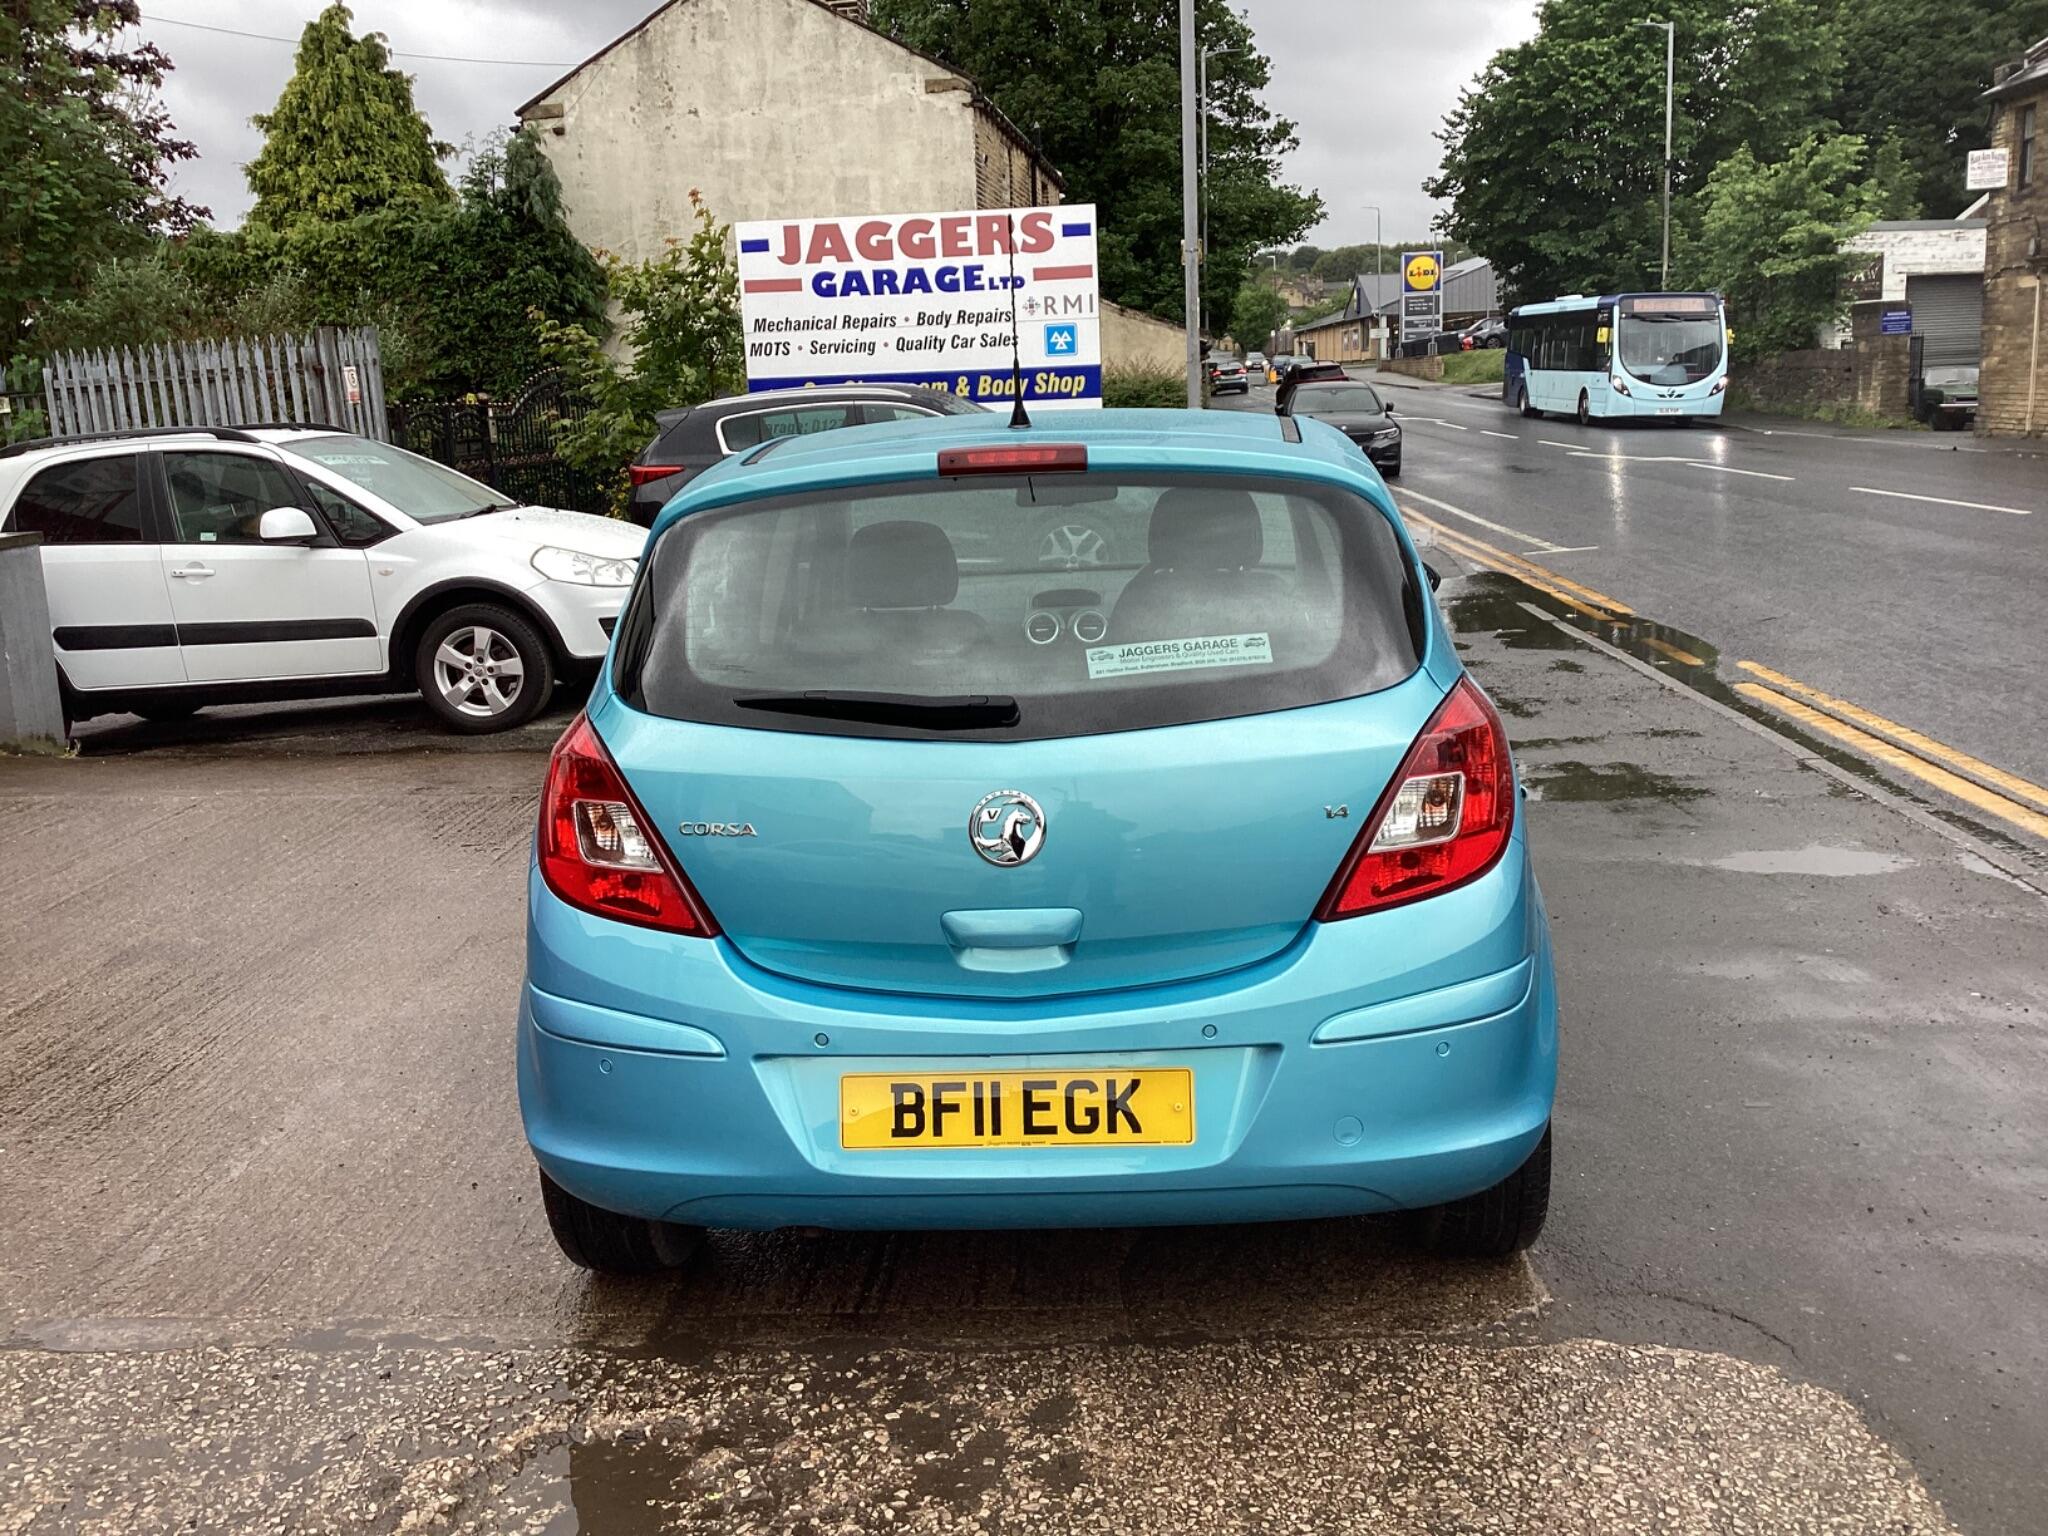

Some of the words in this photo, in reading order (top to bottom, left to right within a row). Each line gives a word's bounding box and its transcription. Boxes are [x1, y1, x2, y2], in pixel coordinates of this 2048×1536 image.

[777, 212, 1055, 265] JAGGERS
[811, 264, 985, 297] GARAGE
[989, 276, 1025, 290] LTD
[1044, 293, 1094, 315] RMI
[753, 315, 837, 333] Mechanical
[842, 313, 897, 331] Repairs
[916, 310, 952, 328] Body
[956, 308, 1013, 326] Repairs
[750, 341, 791, 357] MOTS
[810, 339, 877, 356] Servicing
[896, 335, 946, 353] Quality
[951, 334, 976, 349] Car
[980, 332, 1019, 348] Sales
[955, 376, 970, 397] &
[1034, 371, 1086, 396] Shop
[1119, 643, 1180, 658] JAGGERS
[1183, 638, 1239, 651] GARAGE
[679, 821, 758, 837] CORSA
[890, 1081, 1002, 1138] BF11
[1022, 1078, 1142, 1135] EGK
